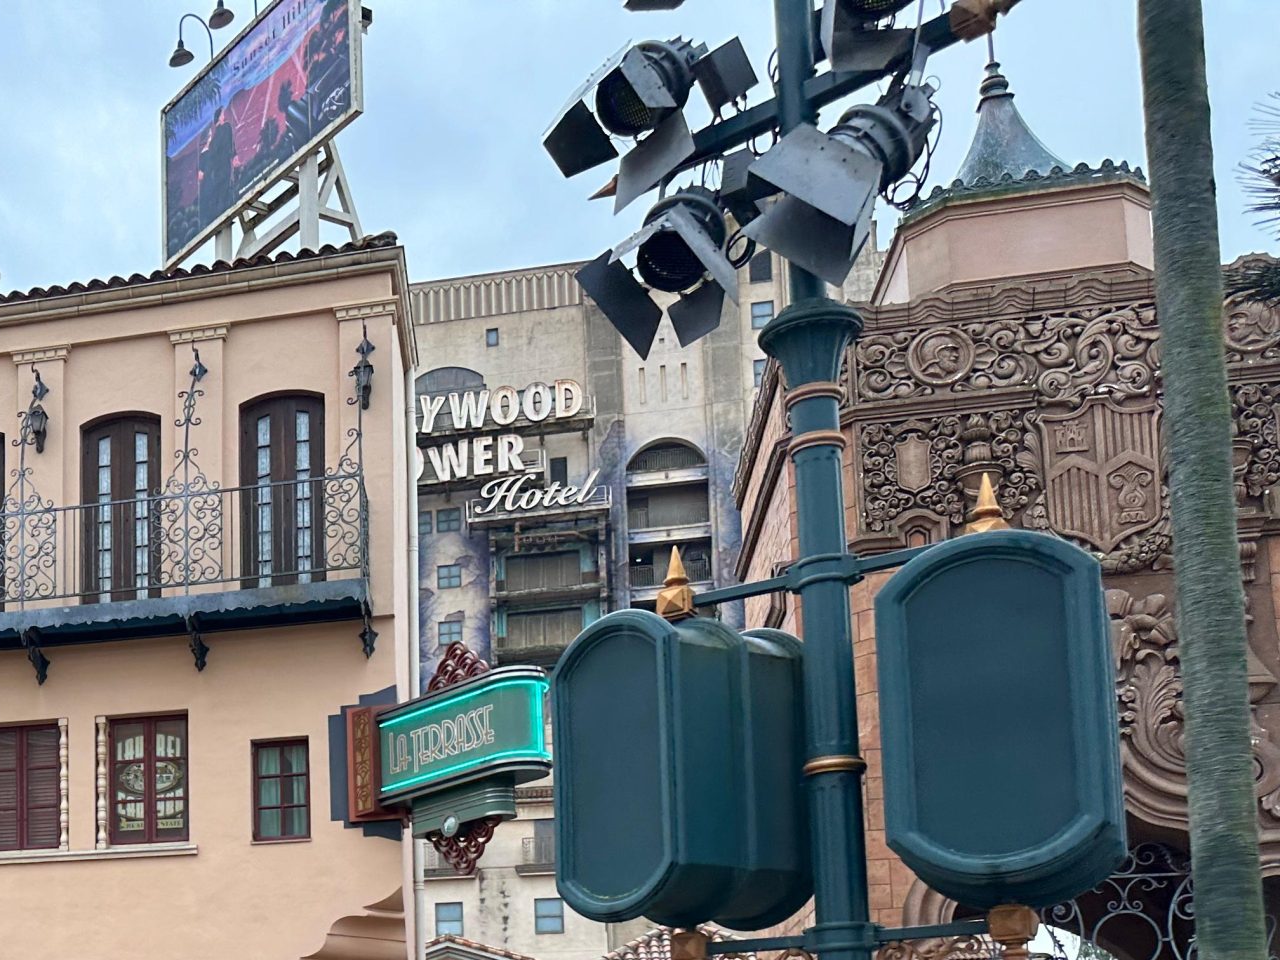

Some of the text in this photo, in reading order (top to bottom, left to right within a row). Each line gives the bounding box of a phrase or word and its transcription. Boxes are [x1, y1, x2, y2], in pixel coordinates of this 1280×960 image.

[417, 379, 582, 433] YWOOD
[474, 468, 600, 514] Hotel
[389, 704, 495, 774] LA TERRASSE
